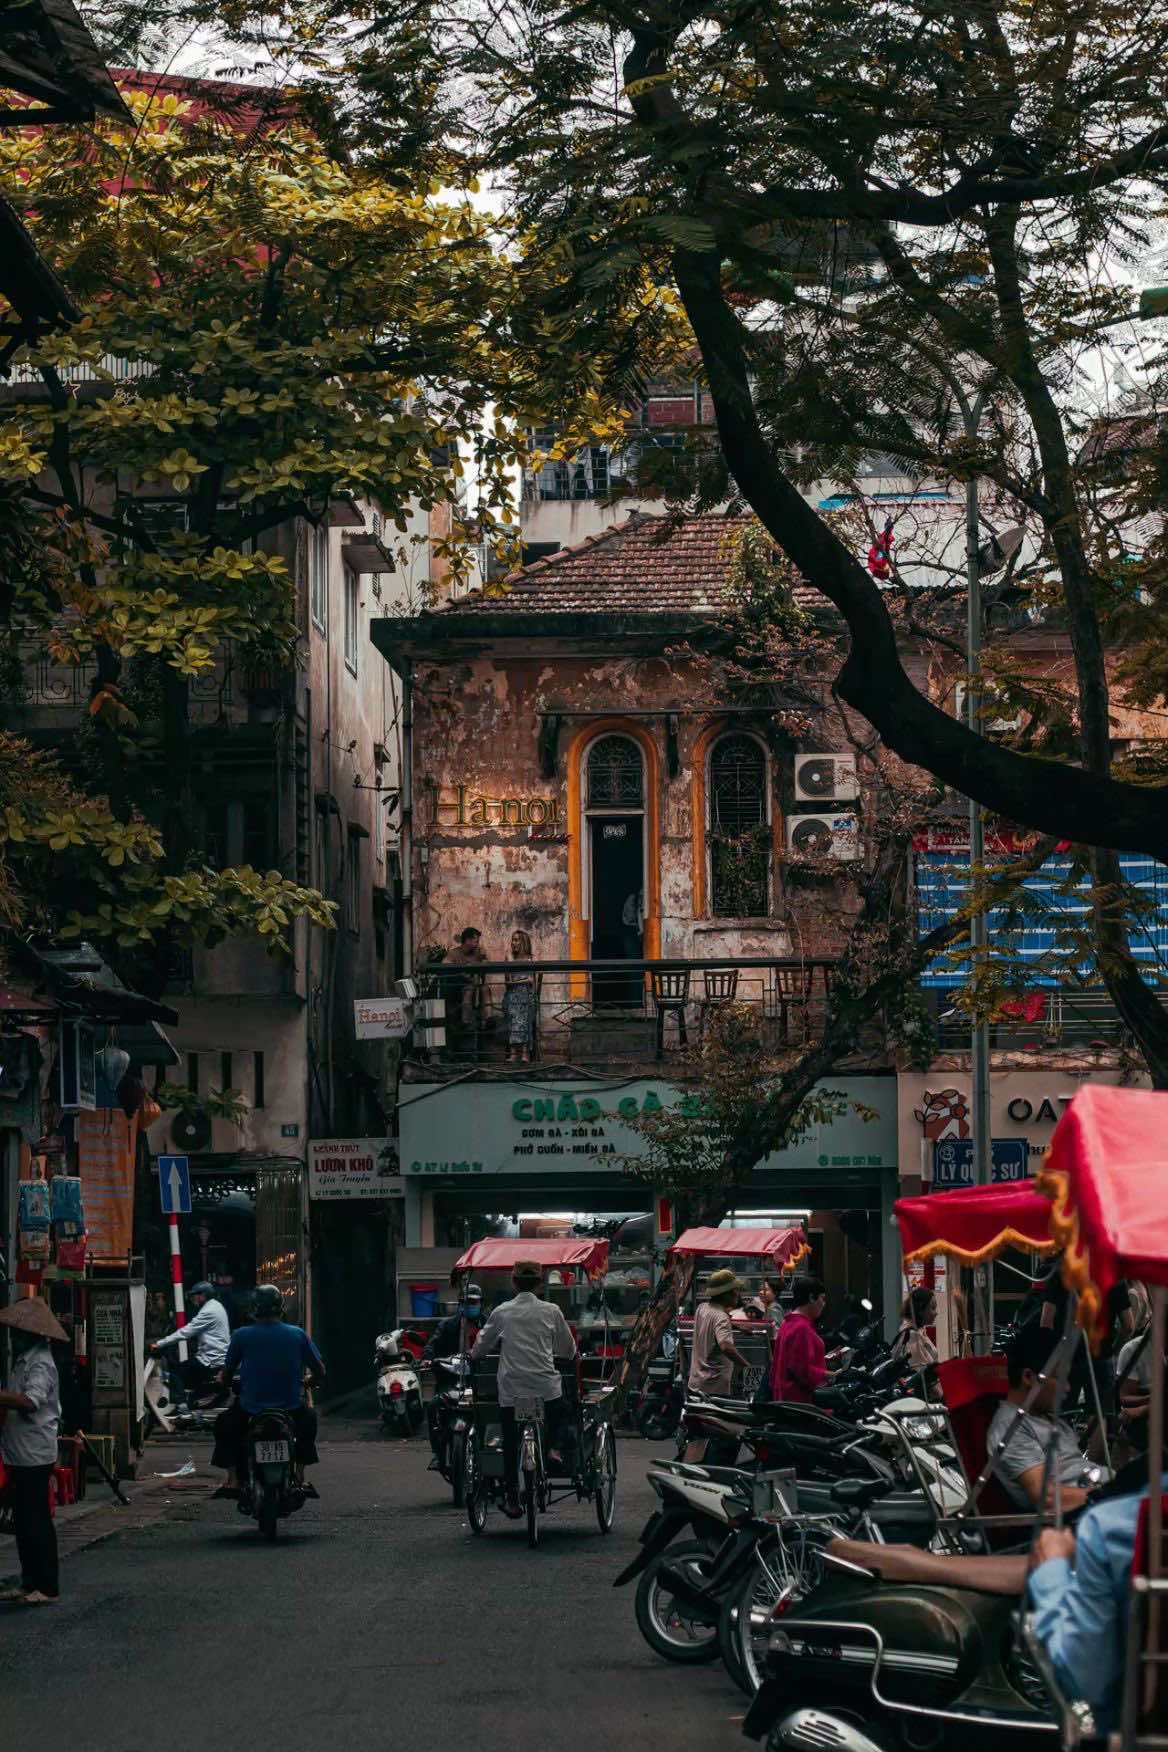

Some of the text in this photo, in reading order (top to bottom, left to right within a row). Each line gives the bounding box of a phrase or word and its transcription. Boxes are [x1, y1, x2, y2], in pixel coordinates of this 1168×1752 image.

[428, 784, 561, 826] Hanoi
[512, 1093, 601, 1122] CHÁO
[941, 1160, 956, 1181] LÝ
[1001, 1161, 1021, 1180] SƯ
